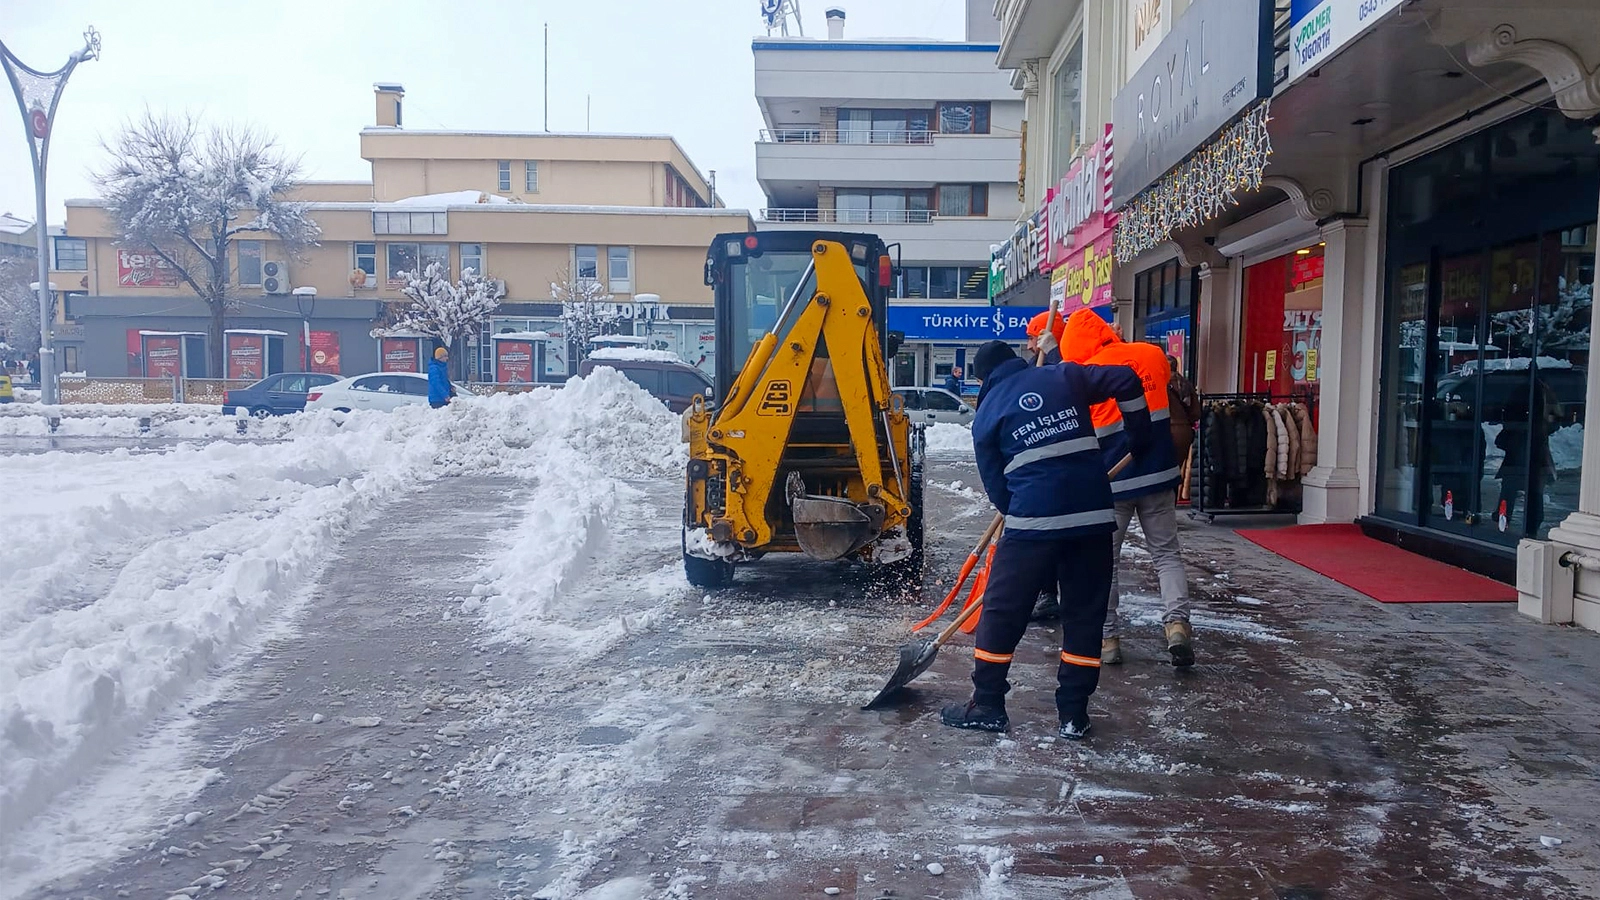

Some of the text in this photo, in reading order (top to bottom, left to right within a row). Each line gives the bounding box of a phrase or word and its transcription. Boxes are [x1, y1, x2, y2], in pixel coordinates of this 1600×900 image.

[1302, 5, 1331, 43] POLMER
[1301, 28, 1330, 64] SİGORTA
[1137, 19, 1210, 140] ROYAL
[1082, 243, 1095, 305] 5
[922, 313, 989, 328] TÜRKİYE
[762, 383, 789, 413] JCB
[1012, 406, 1078, 441] FEN İŞLERİ
[1023, 418, 1080, 447] MÜDÜRLÜĞÜ
